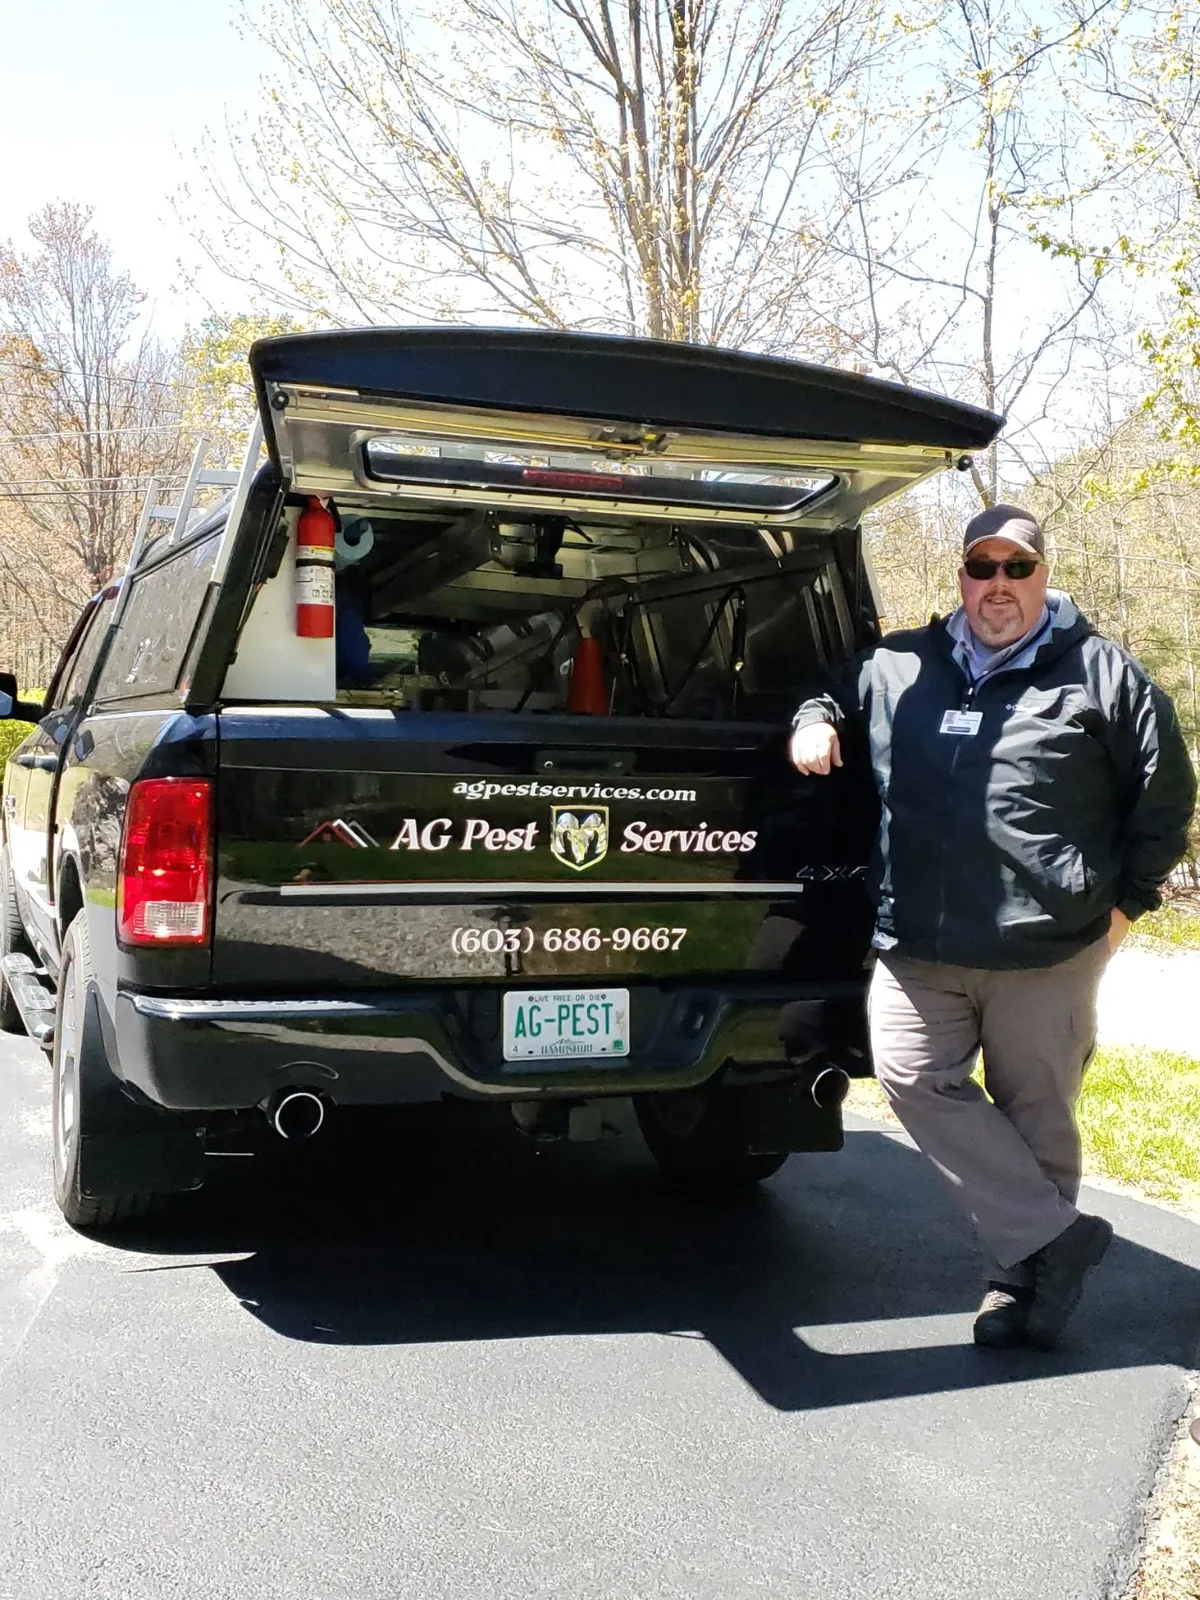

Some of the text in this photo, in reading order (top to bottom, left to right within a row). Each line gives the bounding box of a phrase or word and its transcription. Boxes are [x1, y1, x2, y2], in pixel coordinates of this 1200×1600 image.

[453, 780, 696, 801] agpestservices.com
[389, 818, 758, 852] AG Pest Services
[451, 926, 688, 954] (603) 686-9667
[514, 1003, 614, 1038] AG-PEST
